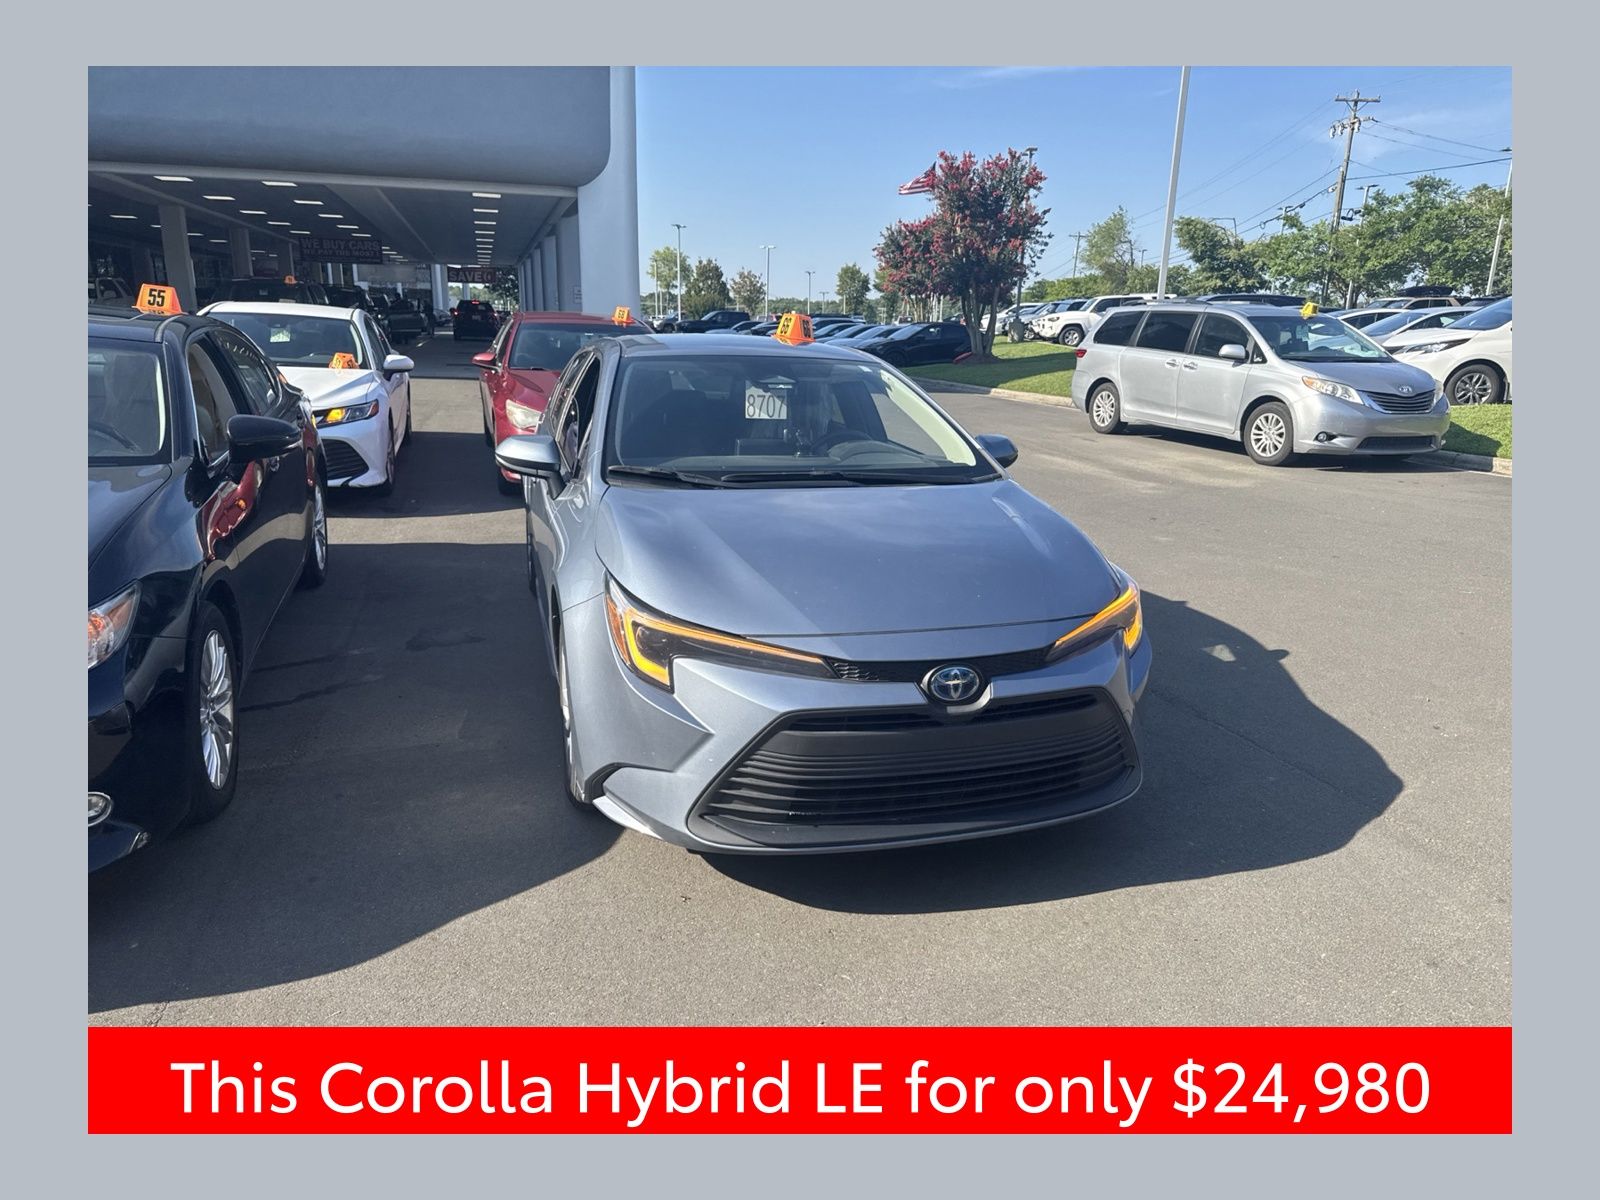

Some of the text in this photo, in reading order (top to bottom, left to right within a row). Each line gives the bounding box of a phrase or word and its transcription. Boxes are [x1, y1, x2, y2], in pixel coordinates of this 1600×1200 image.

[301, 238, 380, 251] WE BUY CARS
[449, 271, 482, 282] SAVE
[147, 288, 166, 307] 55
[747, 393, 785, 418] 8707
